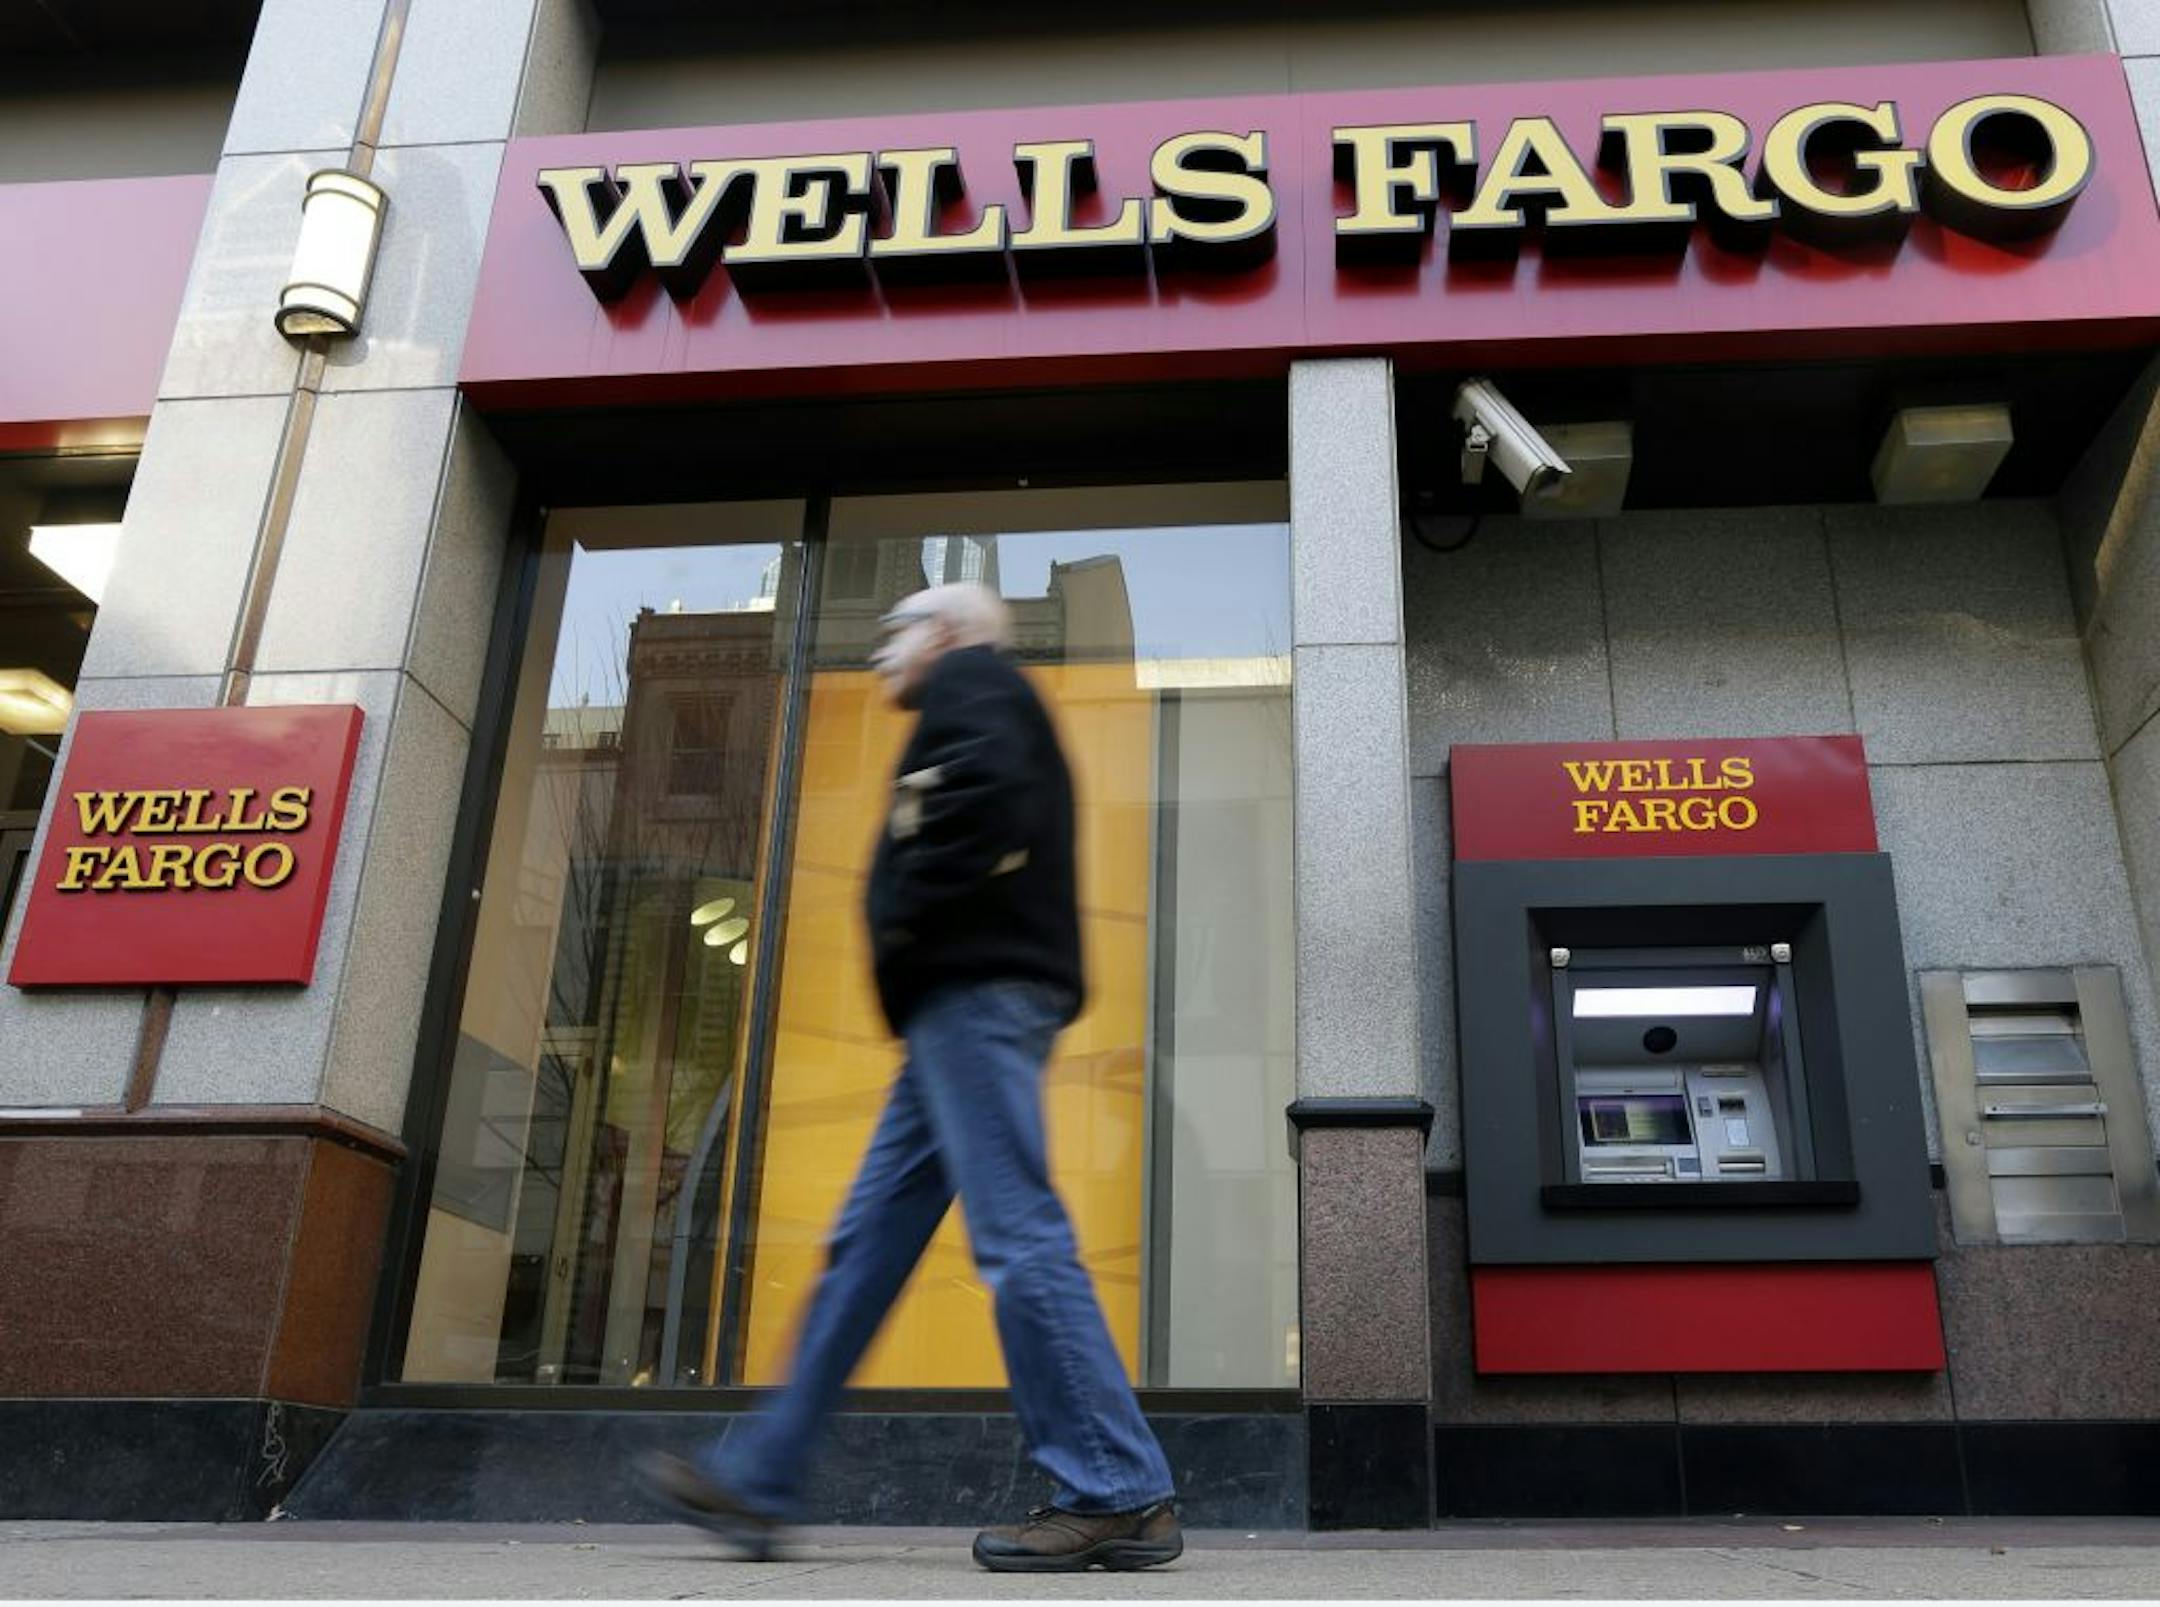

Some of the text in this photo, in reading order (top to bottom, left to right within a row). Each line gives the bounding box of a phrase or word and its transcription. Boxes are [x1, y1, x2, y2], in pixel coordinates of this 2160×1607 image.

[537, 94, 2095, 271] WELLS FARGO
[1562, 757, 1755, 793] WELLS
[73, 786, 312, 835] WELLS
[1572, 796, 1759, 833] FARGO
[56, 841, 296, 891] FARGO
